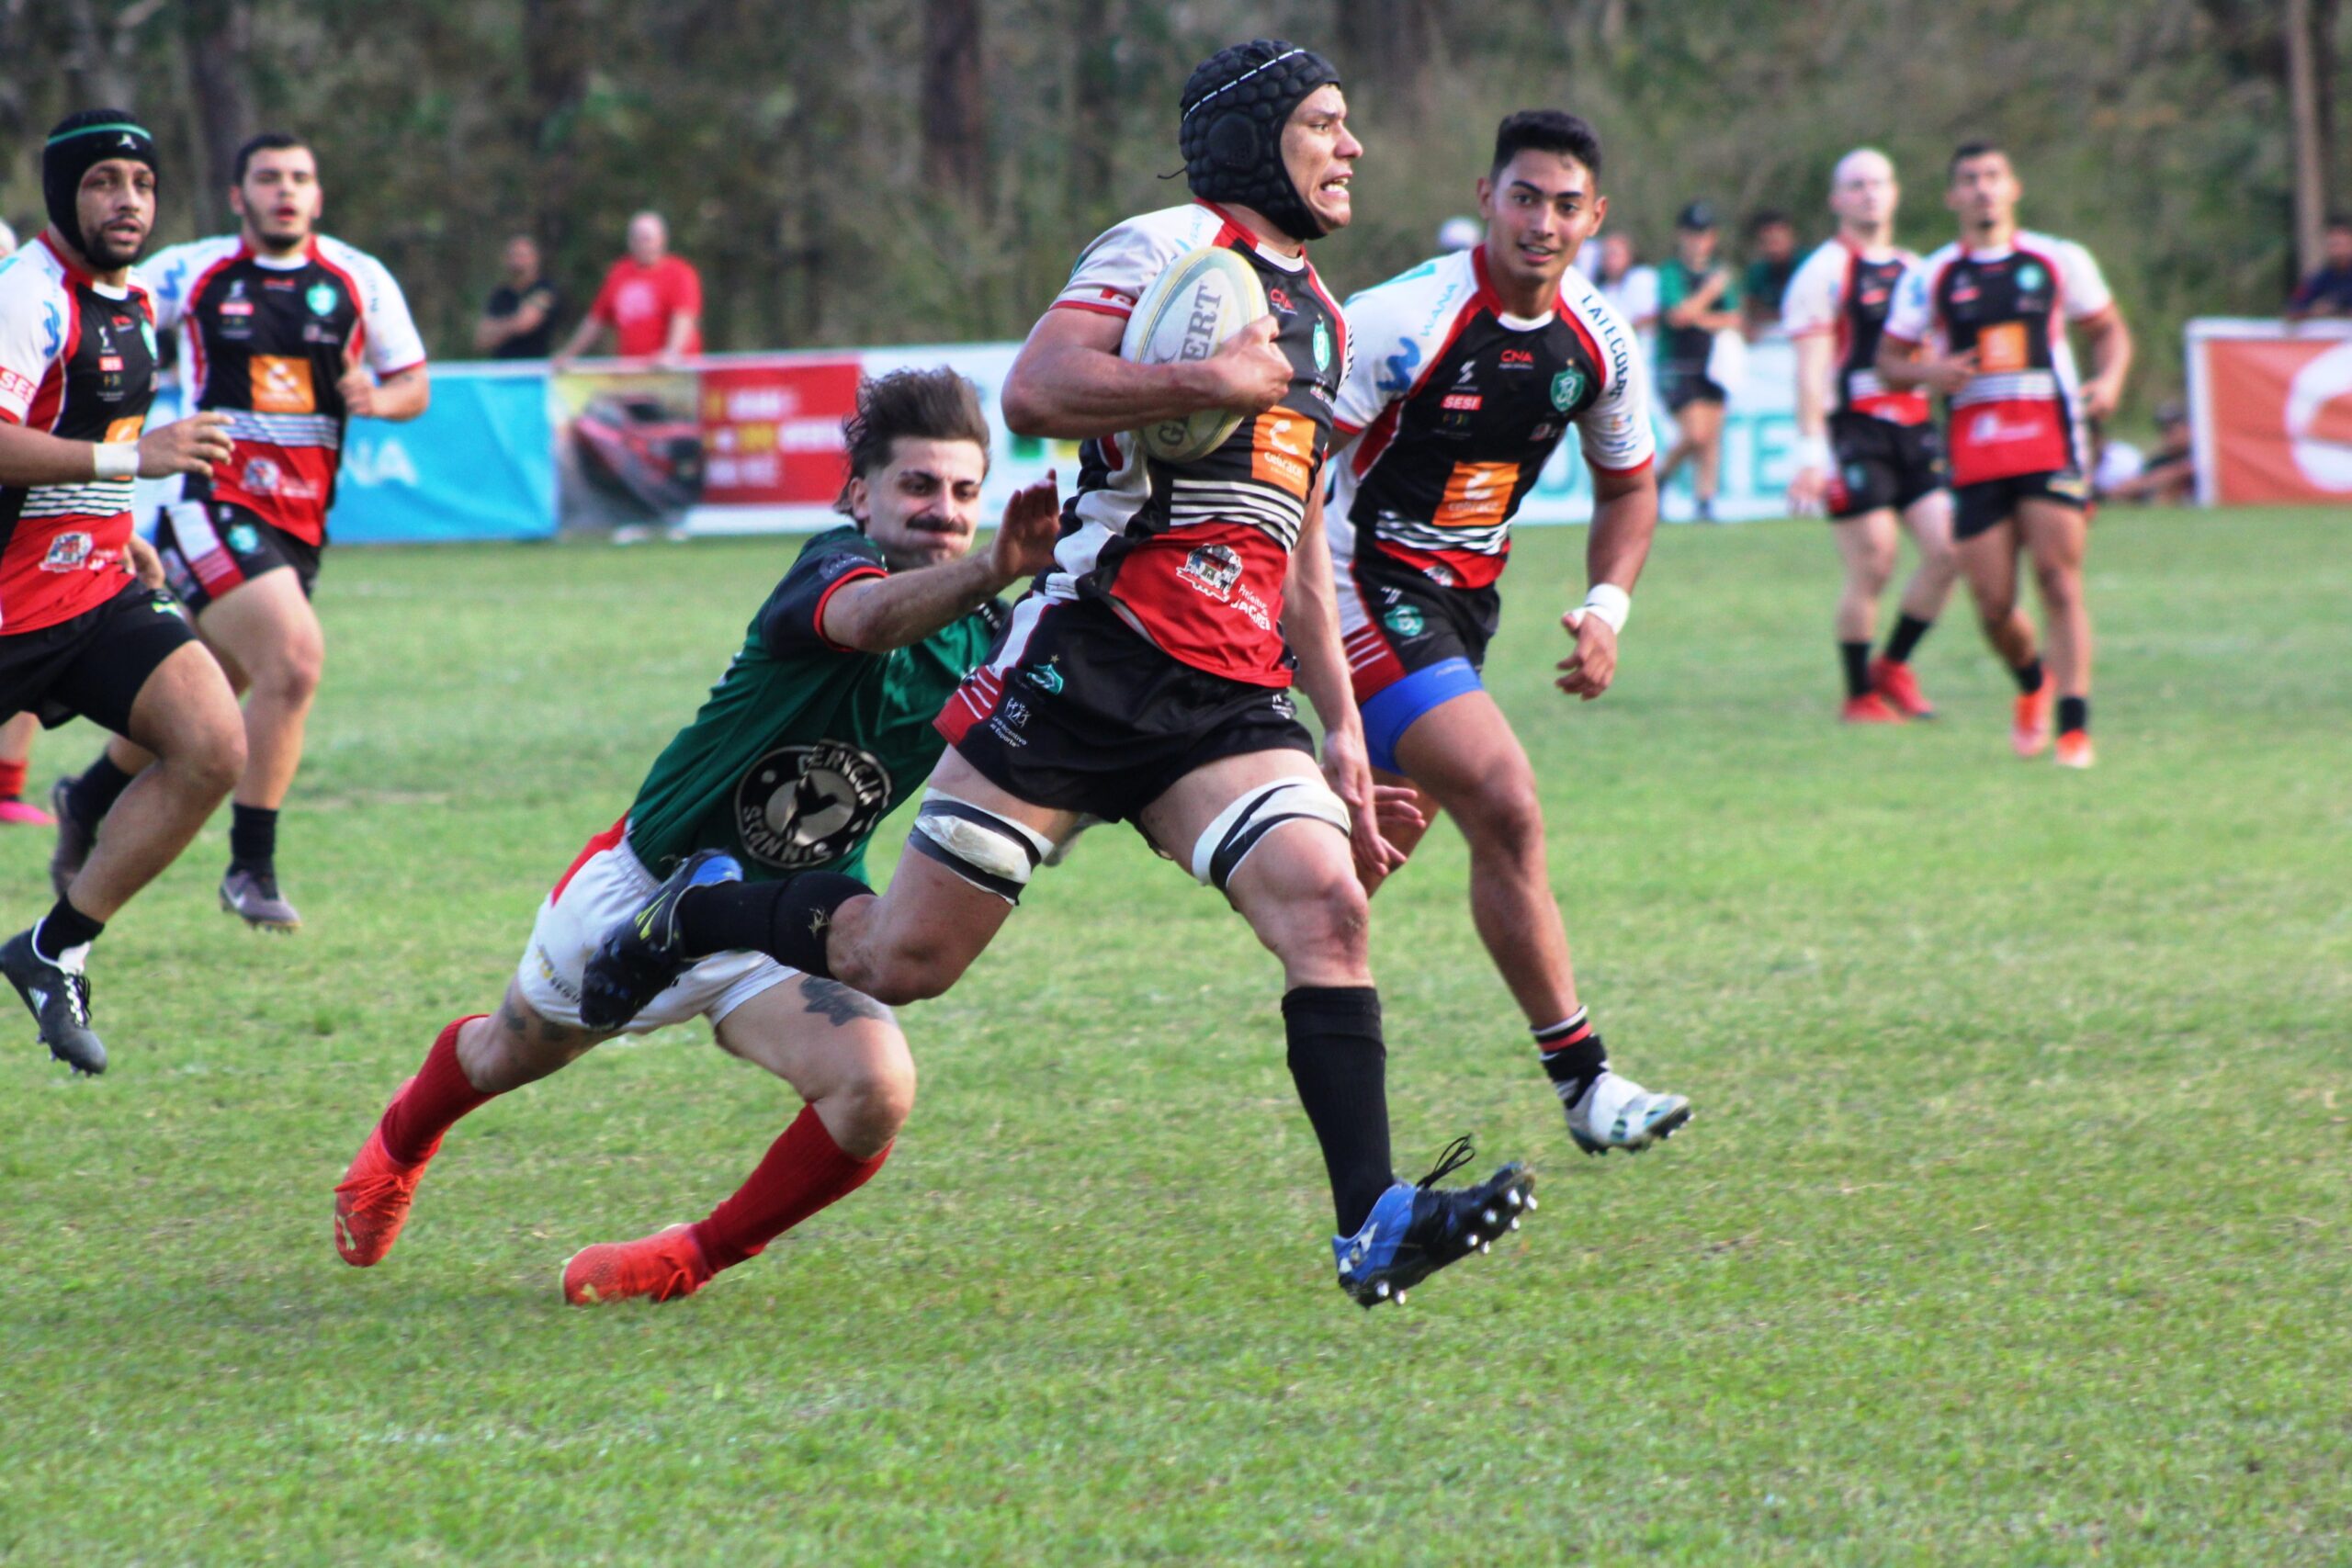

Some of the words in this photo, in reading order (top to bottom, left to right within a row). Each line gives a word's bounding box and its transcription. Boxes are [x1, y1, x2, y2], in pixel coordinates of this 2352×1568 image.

[1499, 348, 1533, 363] CNA
[1442, 395, 1477, 411] SESI
[797, 745, 883, 807] CERVEJA
